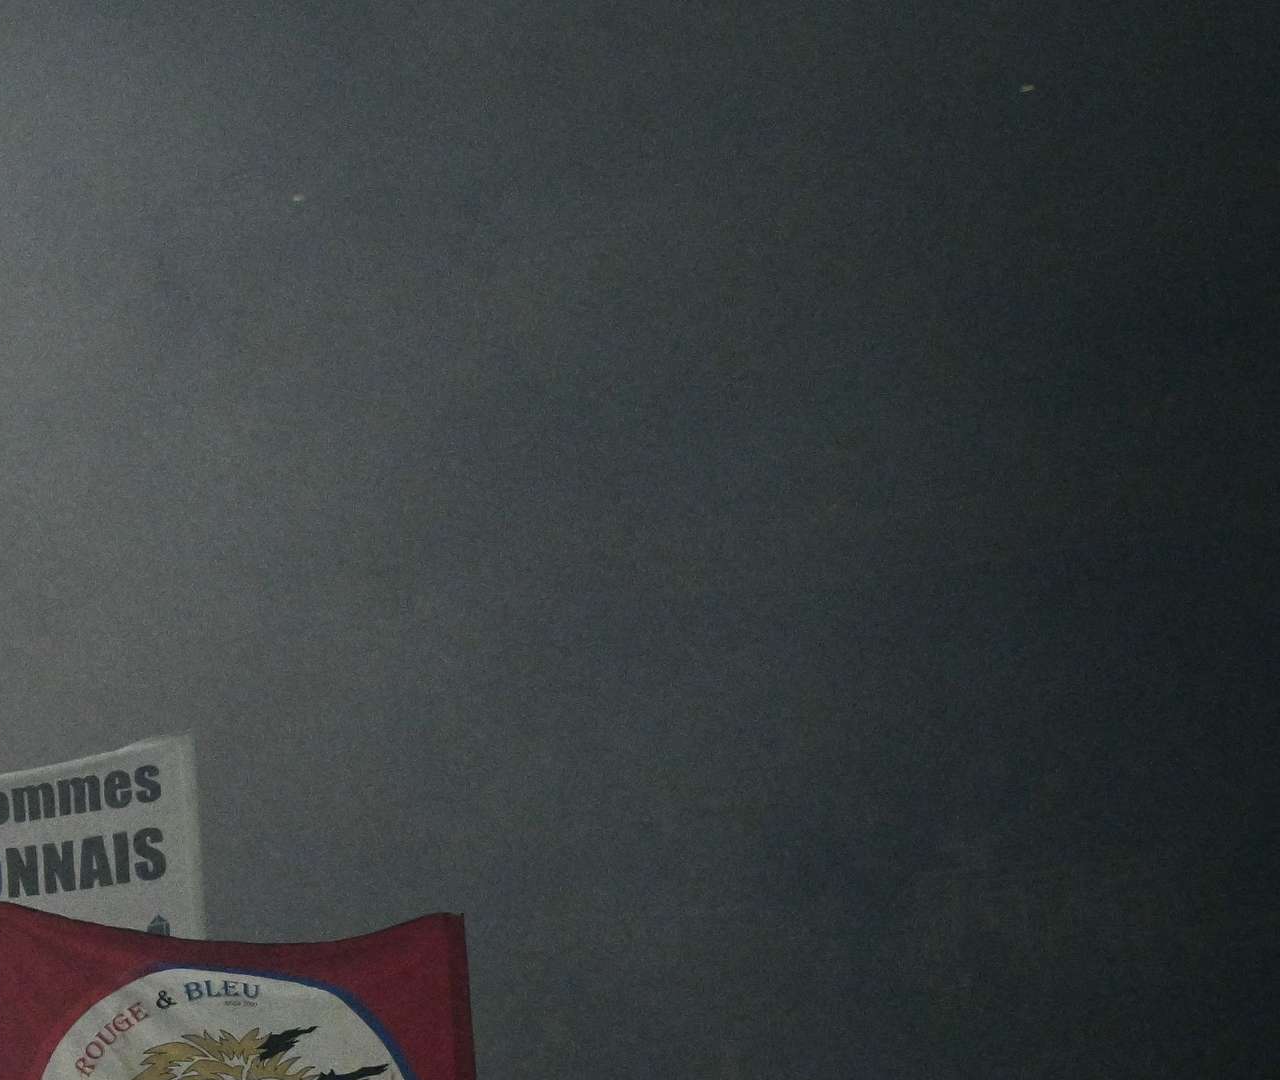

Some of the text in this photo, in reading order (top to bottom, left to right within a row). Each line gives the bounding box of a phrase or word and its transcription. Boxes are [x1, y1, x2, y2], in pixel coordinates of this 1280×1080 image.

[74, 979, 261, 1078] ROUGE & BLEU
